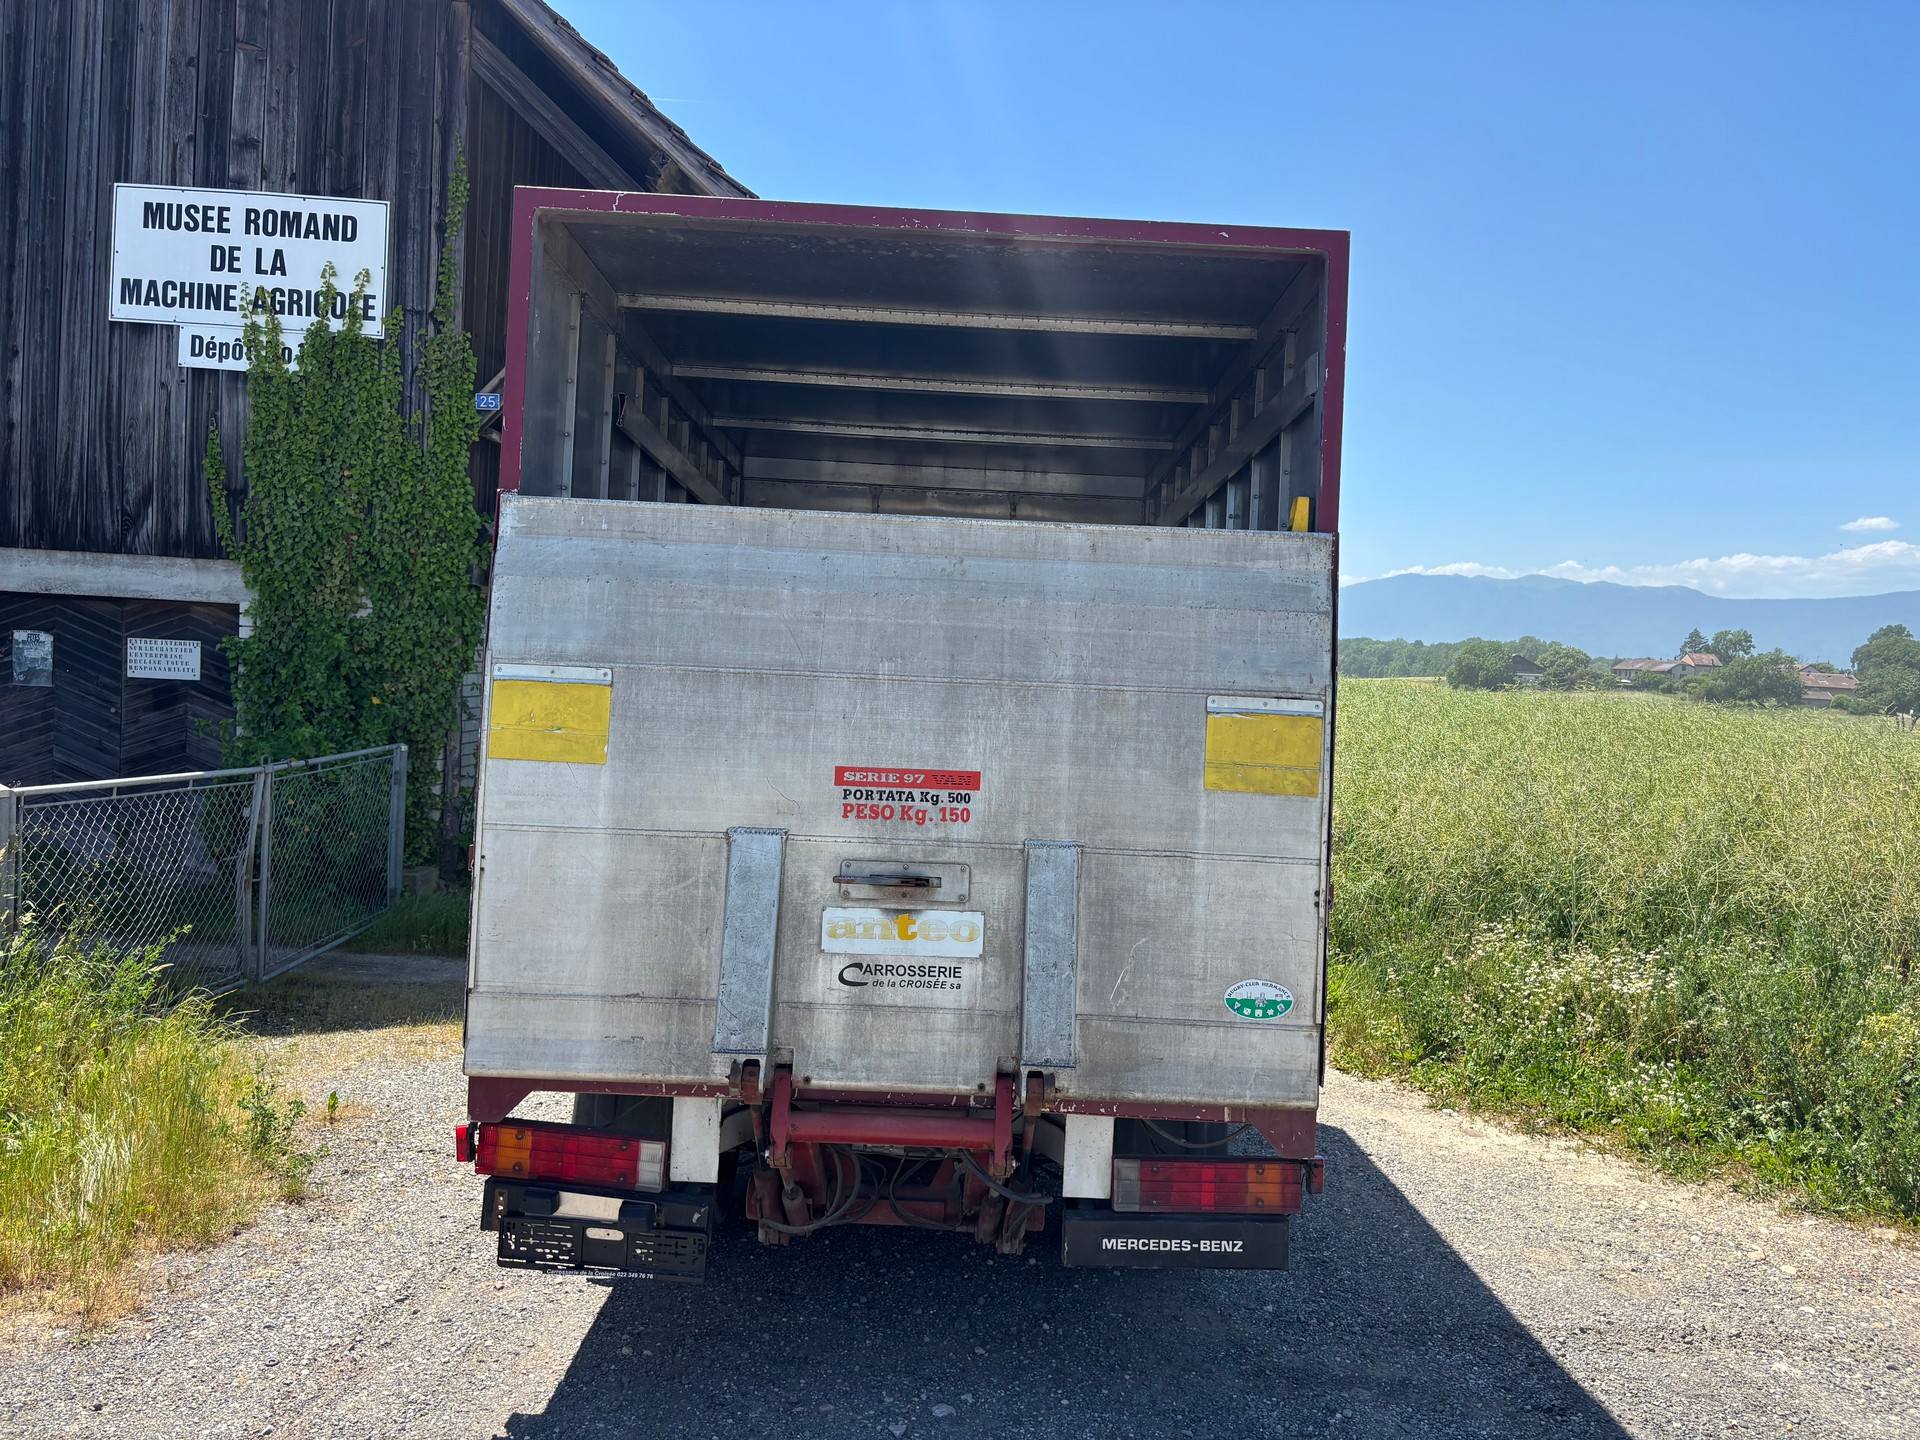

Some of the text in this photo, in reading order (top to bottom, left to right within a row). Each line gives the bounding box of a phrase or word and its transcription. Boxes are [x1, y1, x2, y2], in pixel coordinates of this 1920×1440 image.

[143, 202, 358, 242] MUSEE ROMAND
[210, 245, 287, 276] DE LA
[120, 278, 376, 321] MACHINE AGRICOE
[480, 396, 495, 407] 25
[844, 771, 900, 783] SERIE
[903, 774, 925, 784] 97
[842, 789, 971, 805] PORTATA Kg. 500
[842, 803, 971, 826] PESO Kg. 150
[826, 913, 980, 942] anteo
[838, 963, 962, 987] CARROSSERIE
[872, 977, 961, 990] de la CROISÉE sa
[1102, 1238, 1243, 1252] MERCEDES-BENZ
